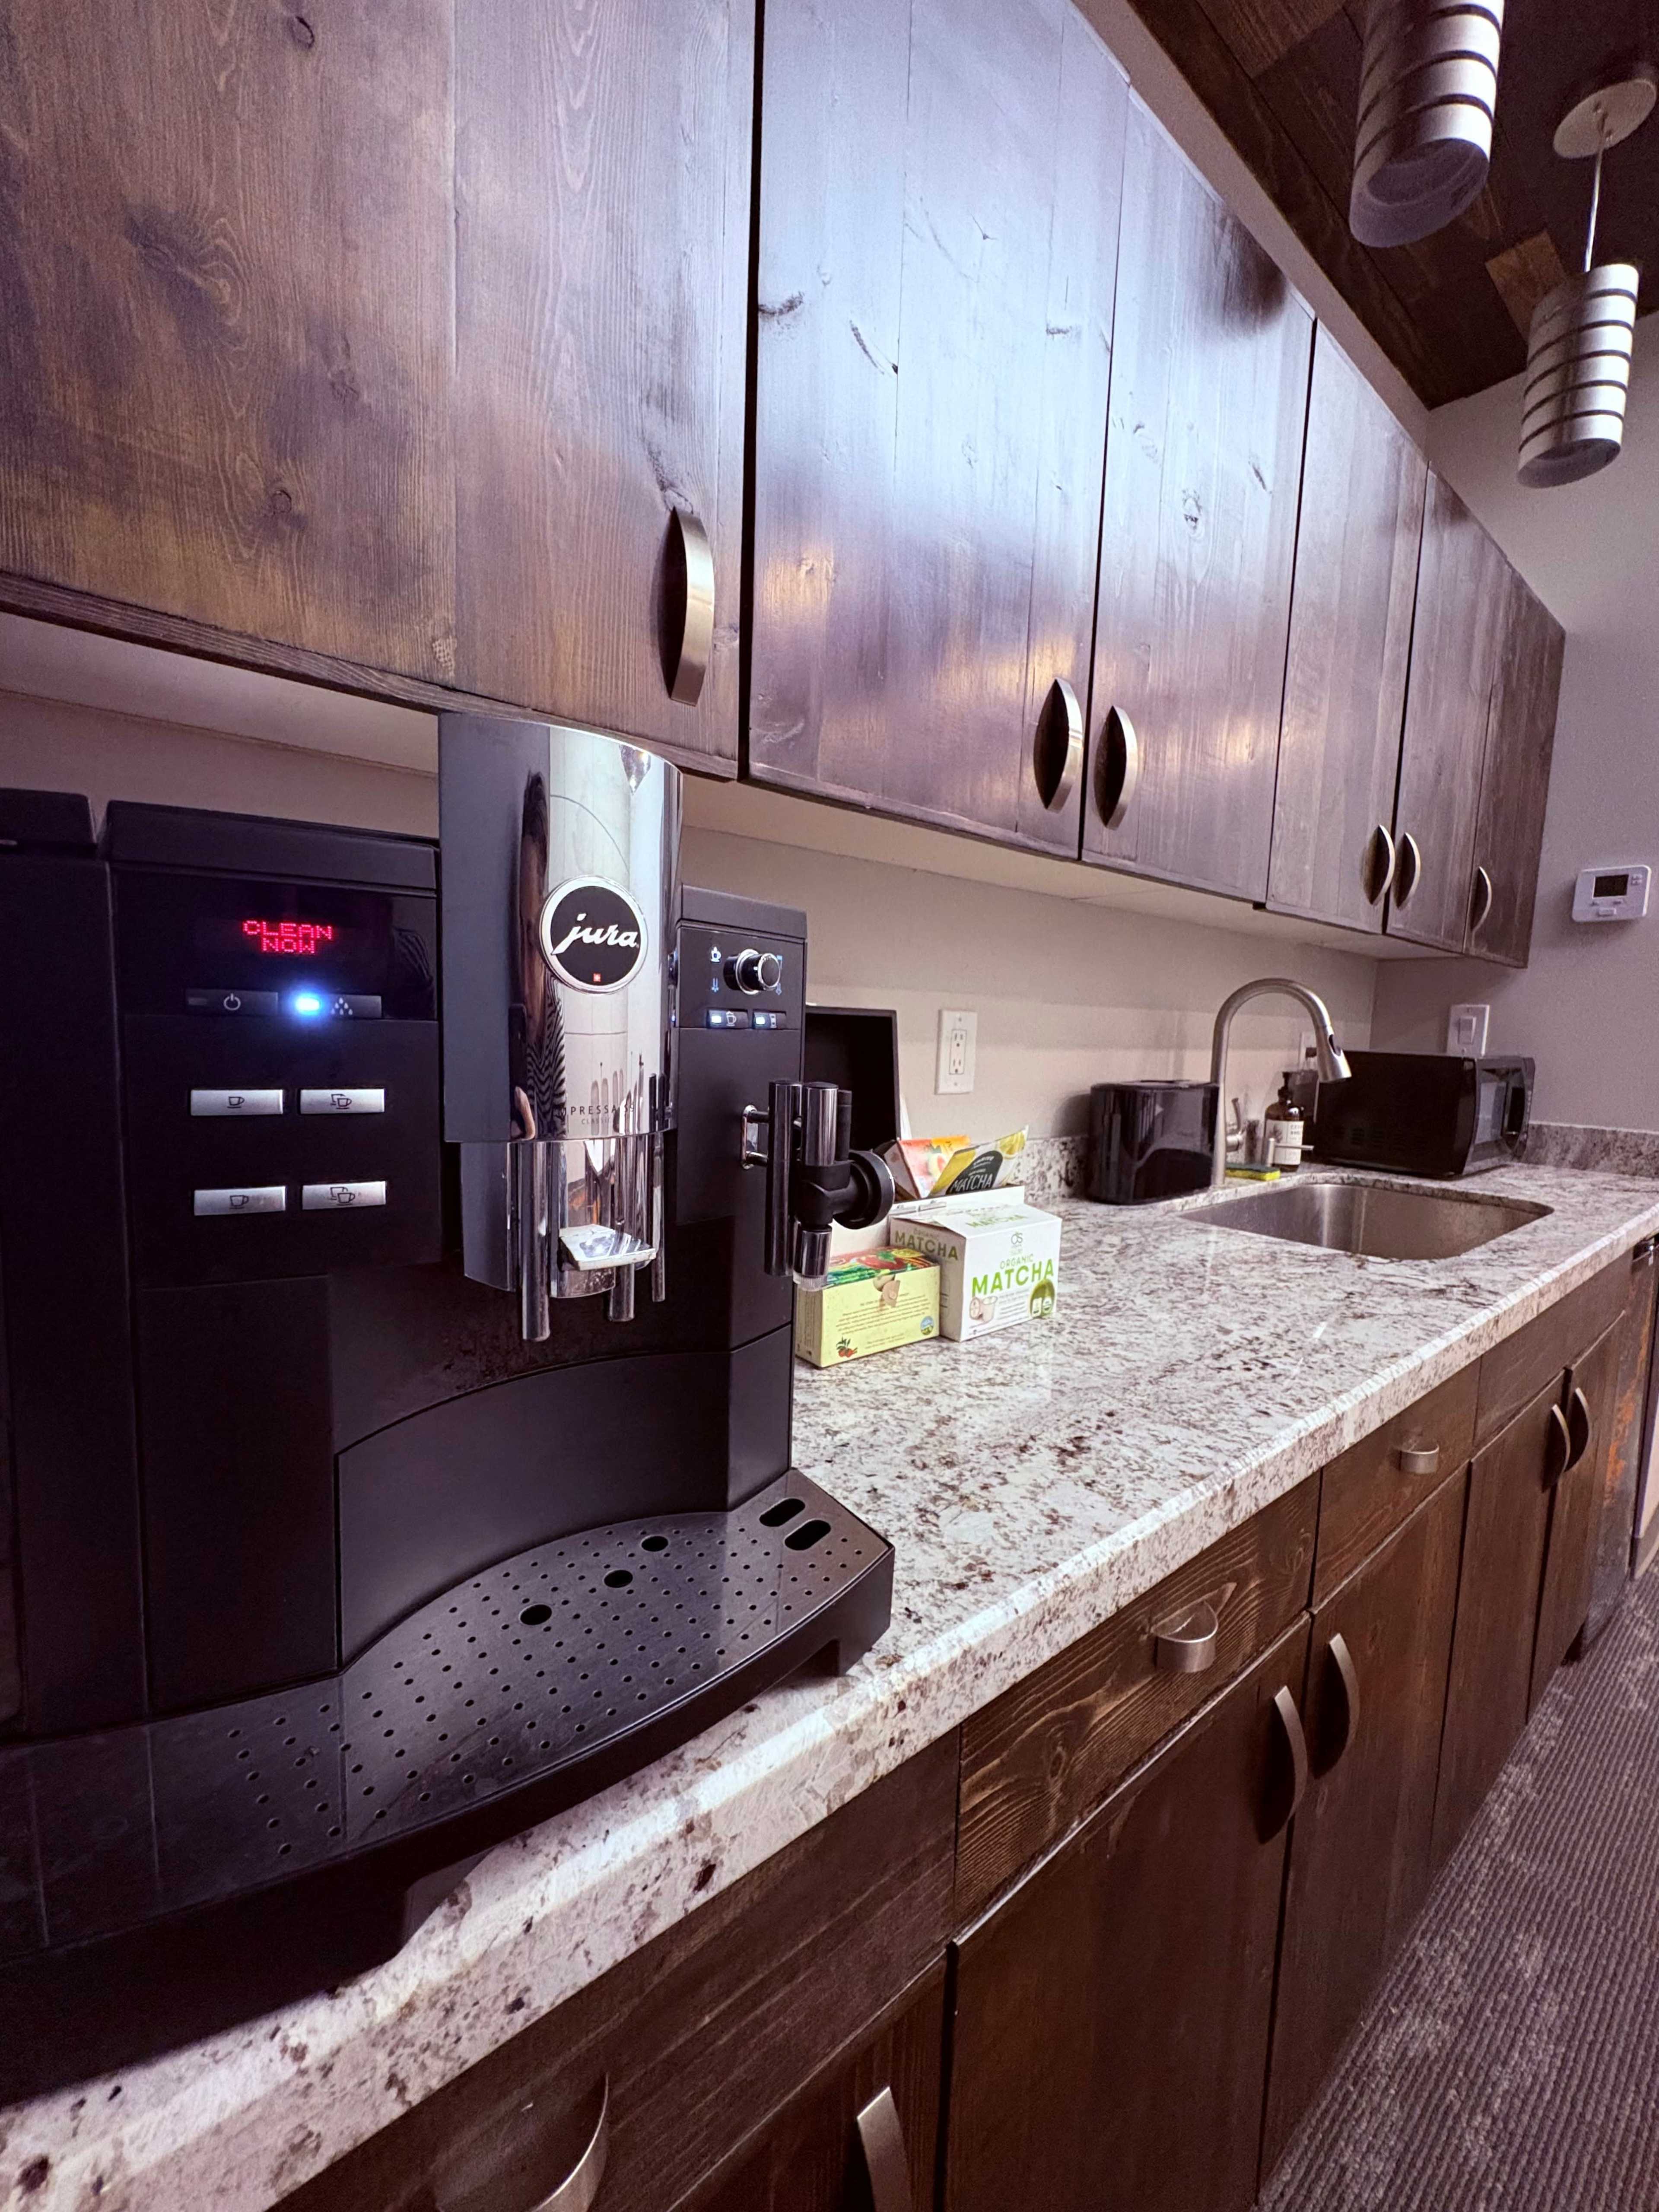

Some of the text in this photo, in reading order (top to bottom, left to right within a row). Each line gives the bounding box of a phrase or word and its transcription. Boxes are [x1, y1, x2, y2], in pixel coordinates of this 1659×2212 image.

[242, 919, 332, 940] CLEAN
[551, 913, 637, 955] jura
[262, 937, 315, 953] NOW
[949, 1173, 993, 1193] MATCHA
[895, 1232, 958, 1261] MATCHA
[999, 1253, 1034, 1269] ORGANIC
[972, 1258, 1054, 1296] MATCHA
